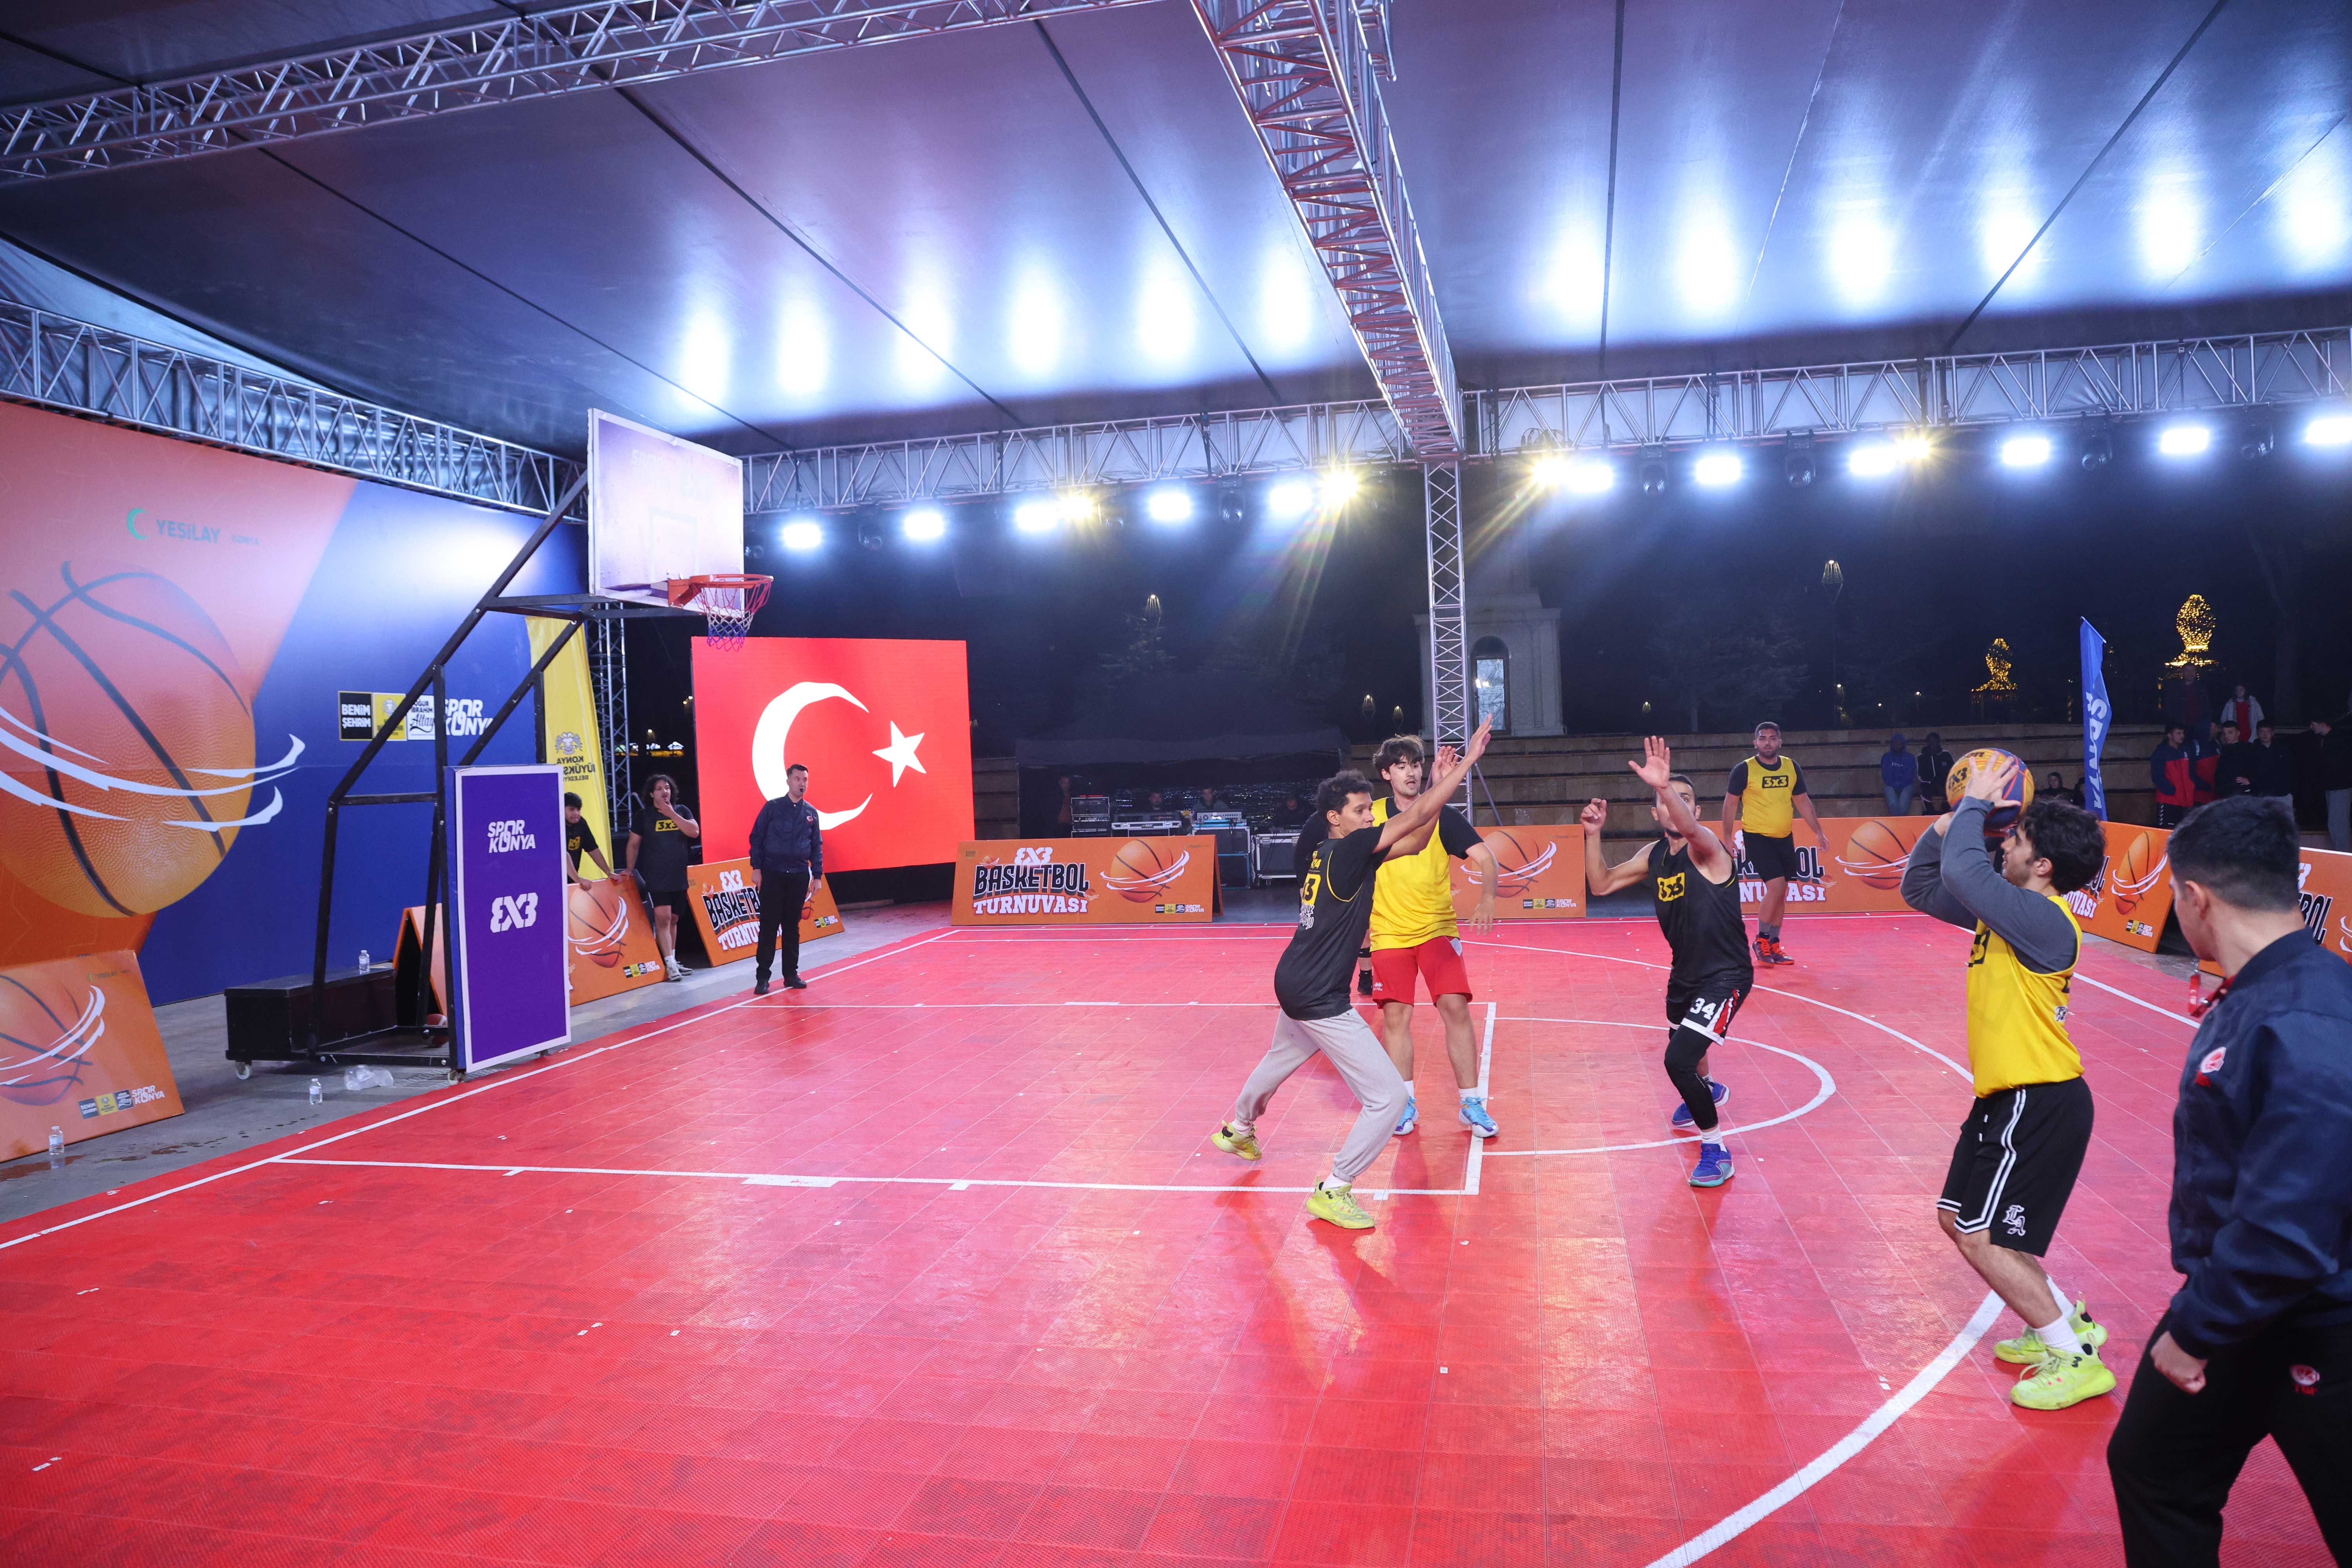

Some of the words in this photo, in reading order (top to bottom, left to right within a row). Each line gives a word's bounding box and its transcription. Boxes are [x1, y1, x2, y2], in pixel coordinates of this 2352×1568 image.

[487, 820, 525, 838] SPOR
[488, 831, 536, 853] KONYA
[973, 862, 1090, 900] BASKETBOL
[701, 886, 761, 931] BASKETB
[973, 895, 1089, 915] TURNUVASI
[717, 920, 760, 951] TURNU
[1690, 997, 1717, 1020] 34
[131, 1085, 156, 1098] SPOR
[134, 1091, 165, 1105] KONYA
